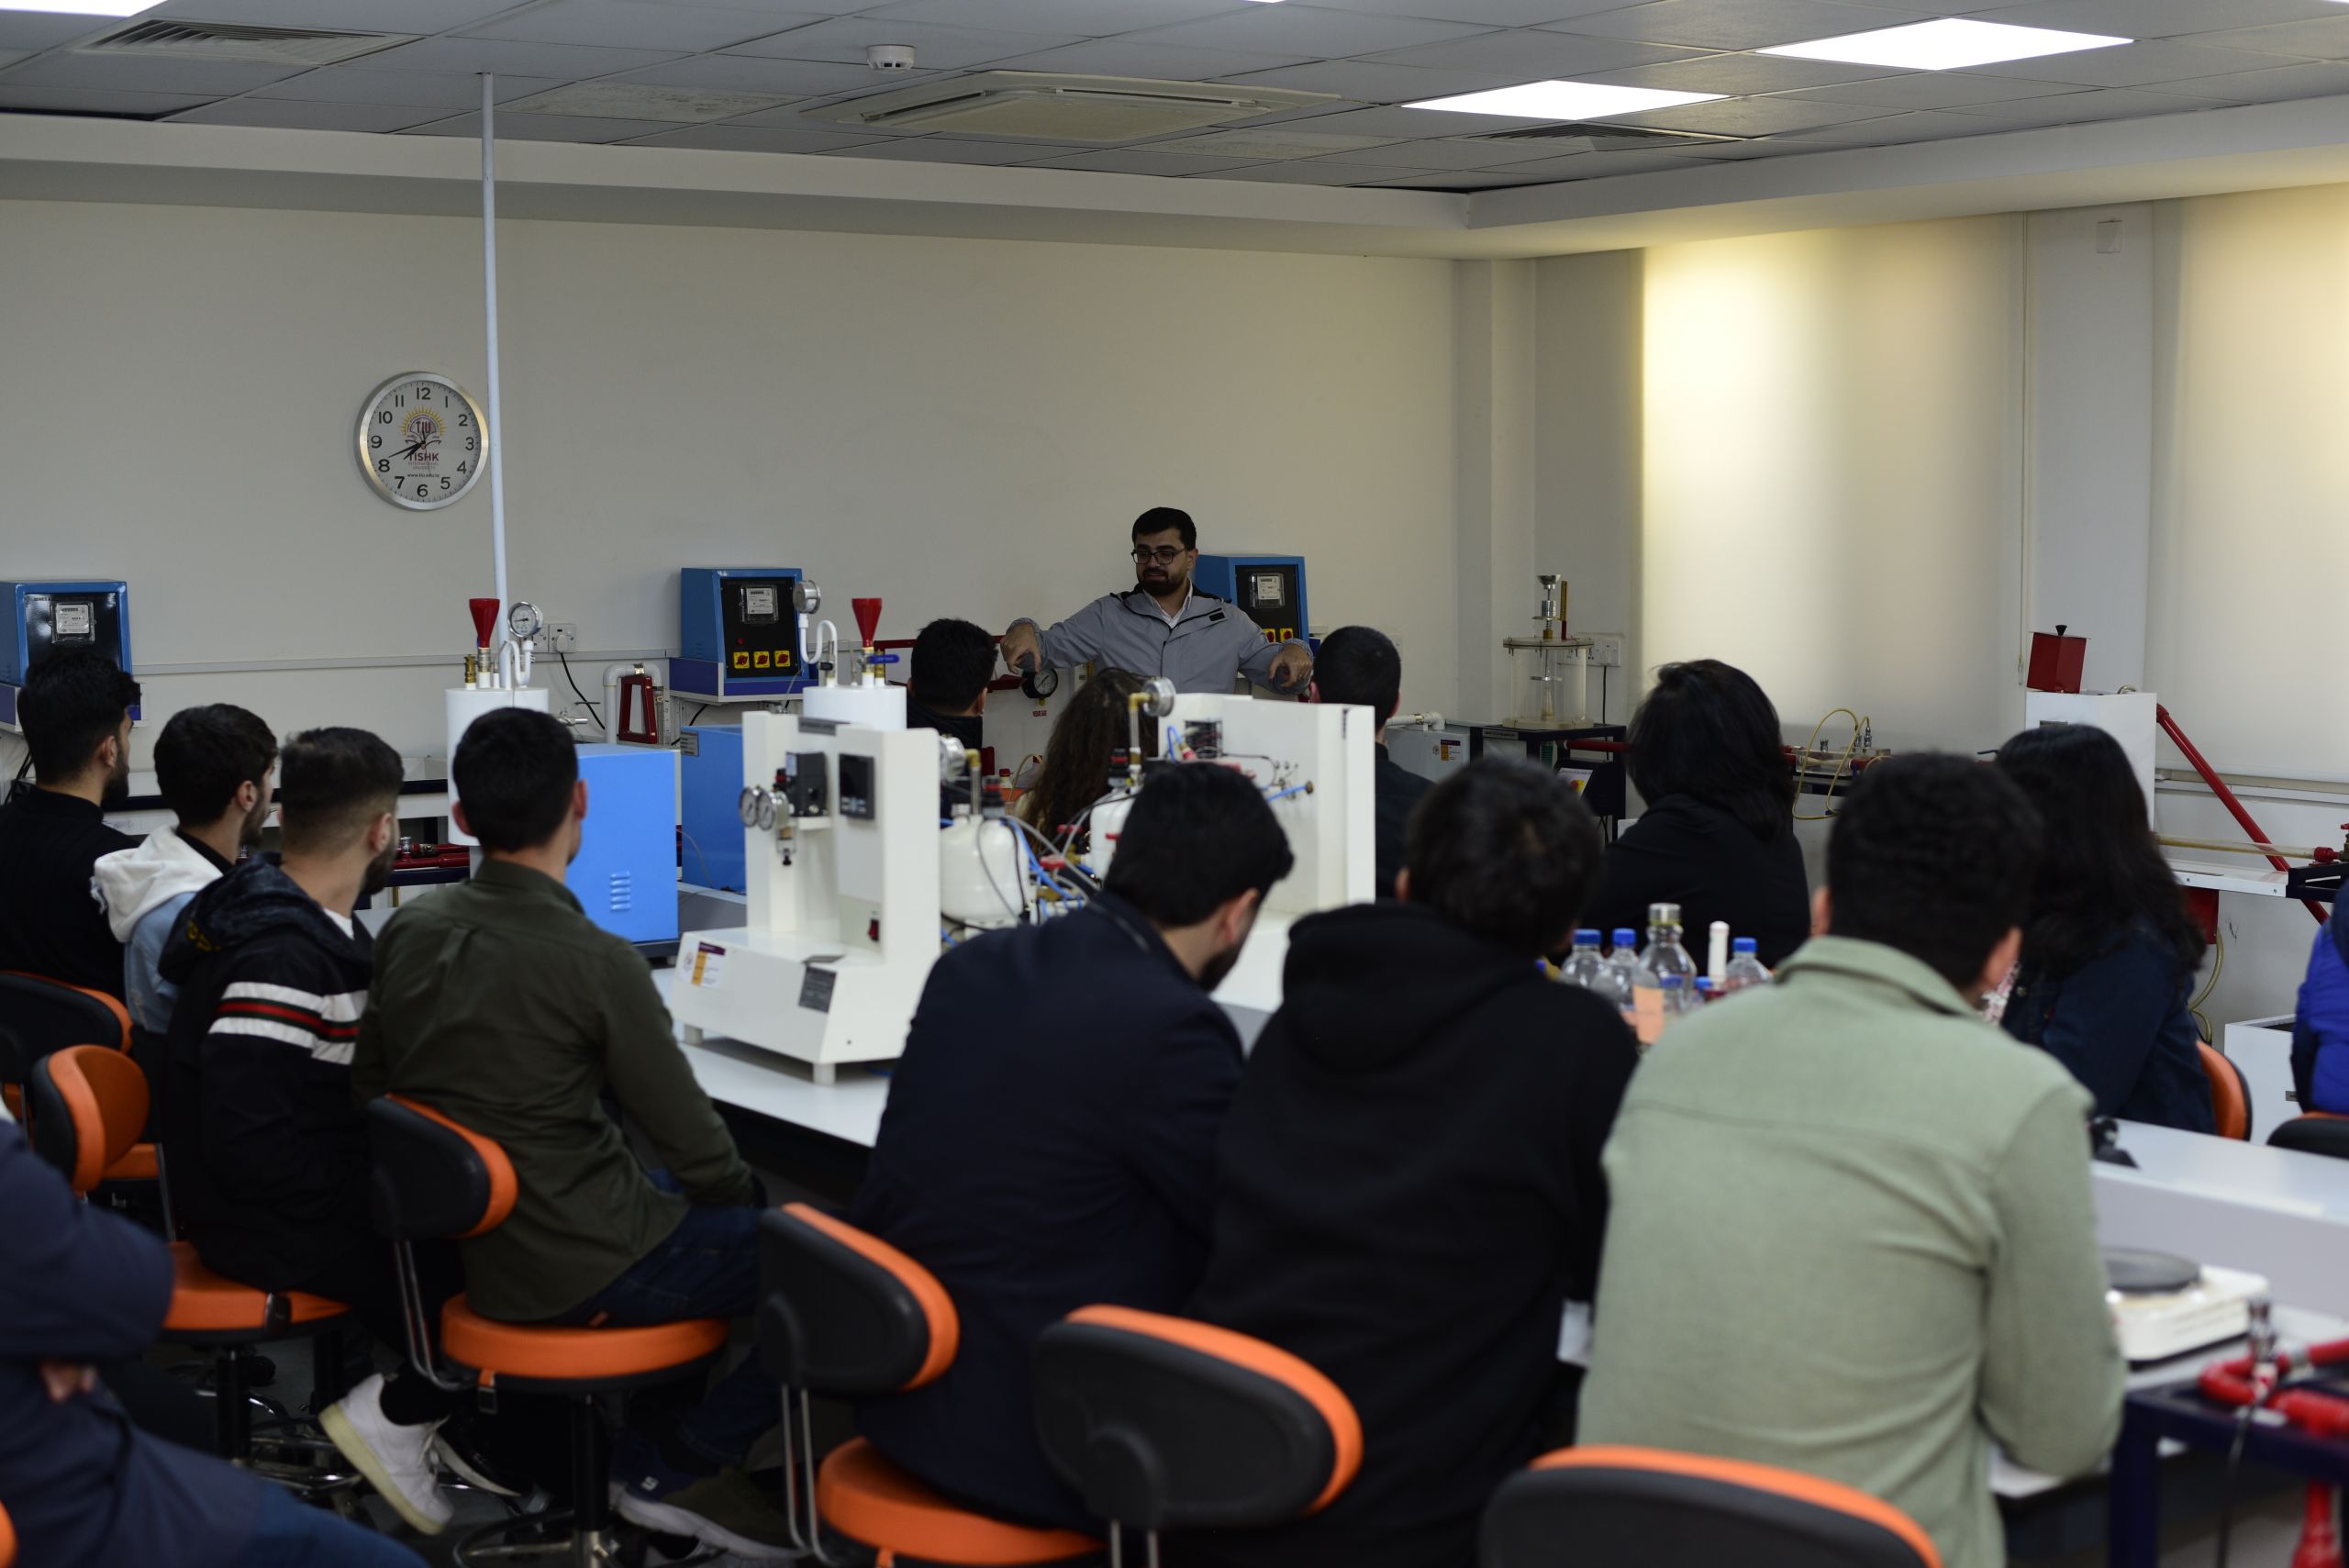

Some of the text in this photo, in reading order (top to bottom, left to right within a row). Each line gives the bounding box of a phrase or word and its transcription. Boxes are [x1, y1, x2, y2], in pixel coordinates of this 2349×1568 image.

[416, 386, 431, 400] 12
[395, 395, 405, 407] 11
[445, 395, 449, 408] 1
[378, 410, 393, 424] 10
[458, 414, 468, 427] 2
[416, 421, 431, 434] TIU
[371, 435, 383, 449] 9
[464, 437, 474, 450] 3
[378, 459, 390, 473] 8
[456, 461, 467, 474] 4
[395, 475, 405, 489] 7
[440, 476, 451, 490] 5
[417, 484, 429, 497] 6
